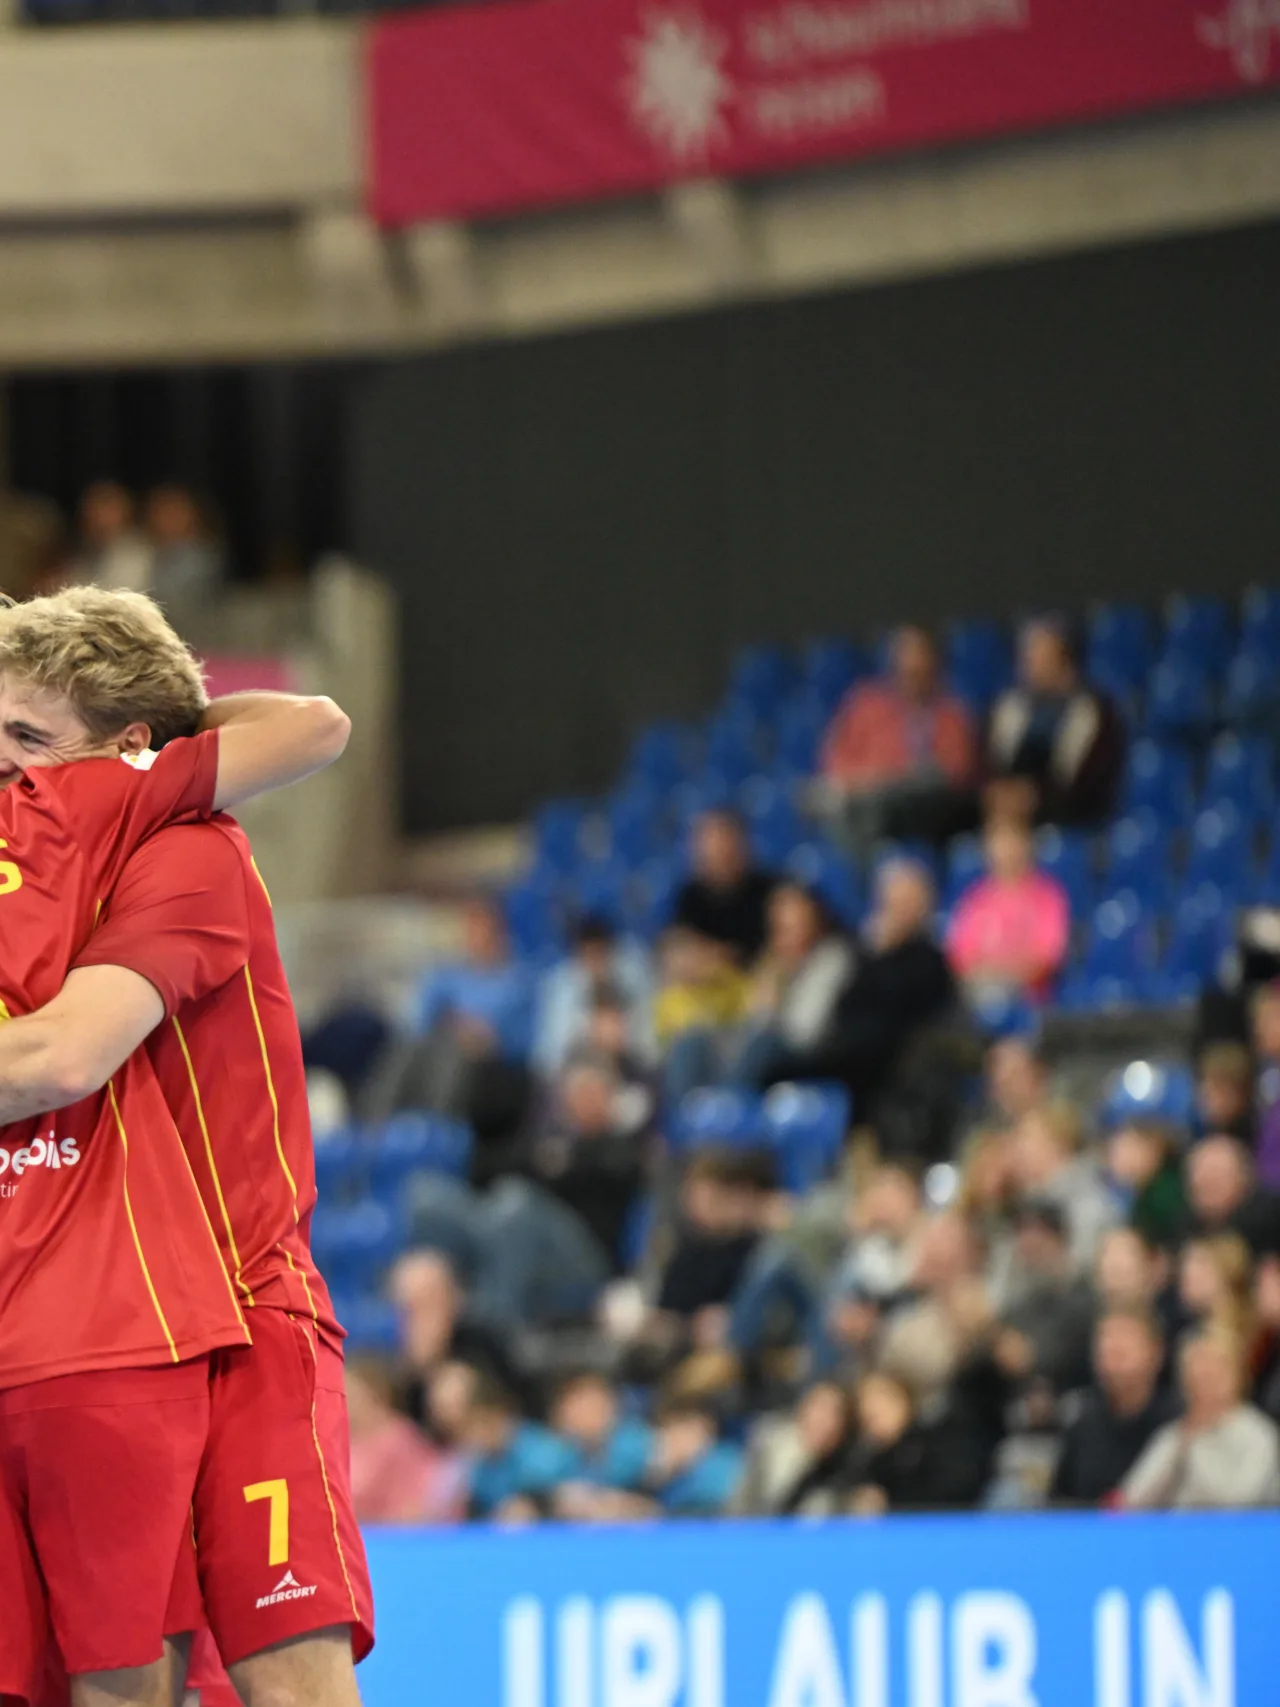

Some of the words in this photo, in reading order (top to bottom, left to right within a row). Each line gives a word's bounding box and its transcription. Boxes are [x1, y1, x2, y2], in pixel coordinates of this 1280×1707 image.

[243, 1478, 289, 1567] 7
[255, 1585, 318, 1609] MERCURY
[1092, 1585, 1237, 1707] IN
